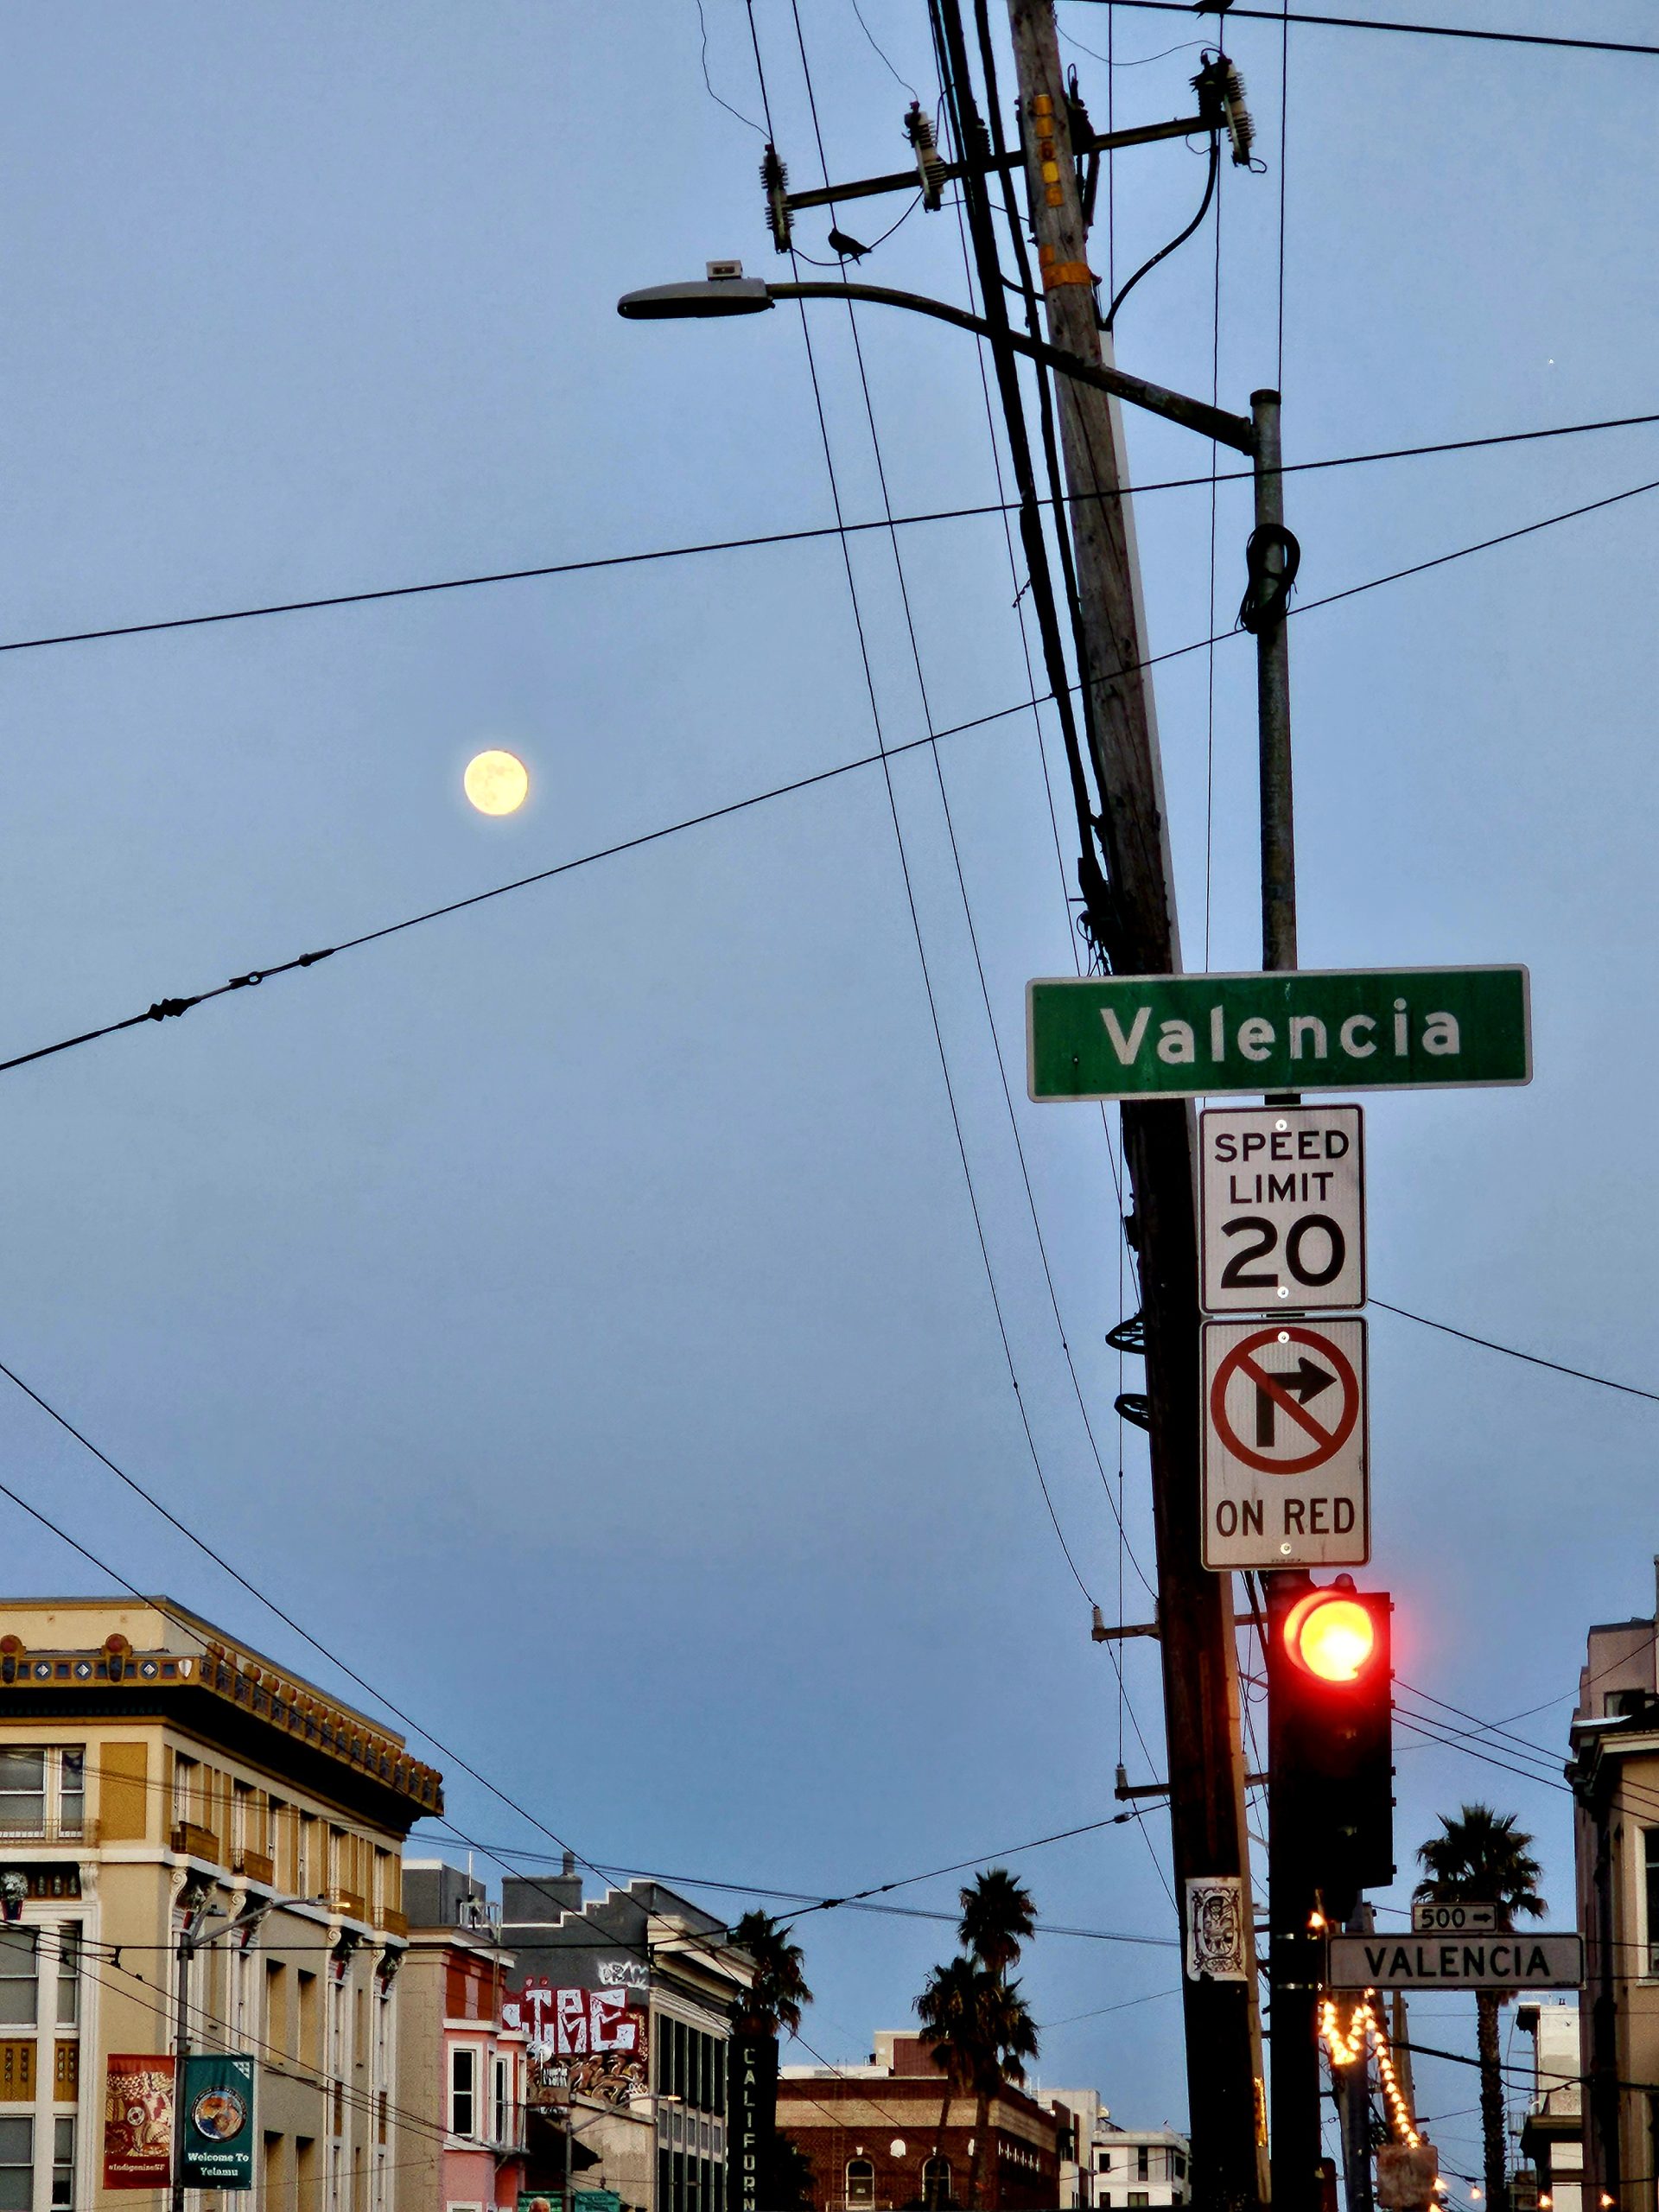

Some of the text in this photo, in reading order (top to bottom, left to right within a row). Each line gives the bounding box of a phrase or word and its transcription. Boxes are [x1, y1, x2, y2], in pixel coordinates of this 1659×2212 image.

[1099, 997, 1461, 1065] Valencia
[1215, 1130, 1350, 1162] SPEED
[1230, 1172, 1334, 1204] LIMIT
[1221, 1214, 1345, 1288] 20
[1216, 1497, 1355, 1537] ON RED
[1421, 1908, 1466, 1929] 500
[1364, 1946, 1551, 1977] VALENCIA
[744, 2048, 756, 2211] CALIFORN
[188, 2152, 250, 2162] Welcome To
[200, 2167, 238, 2176] Yelamu
